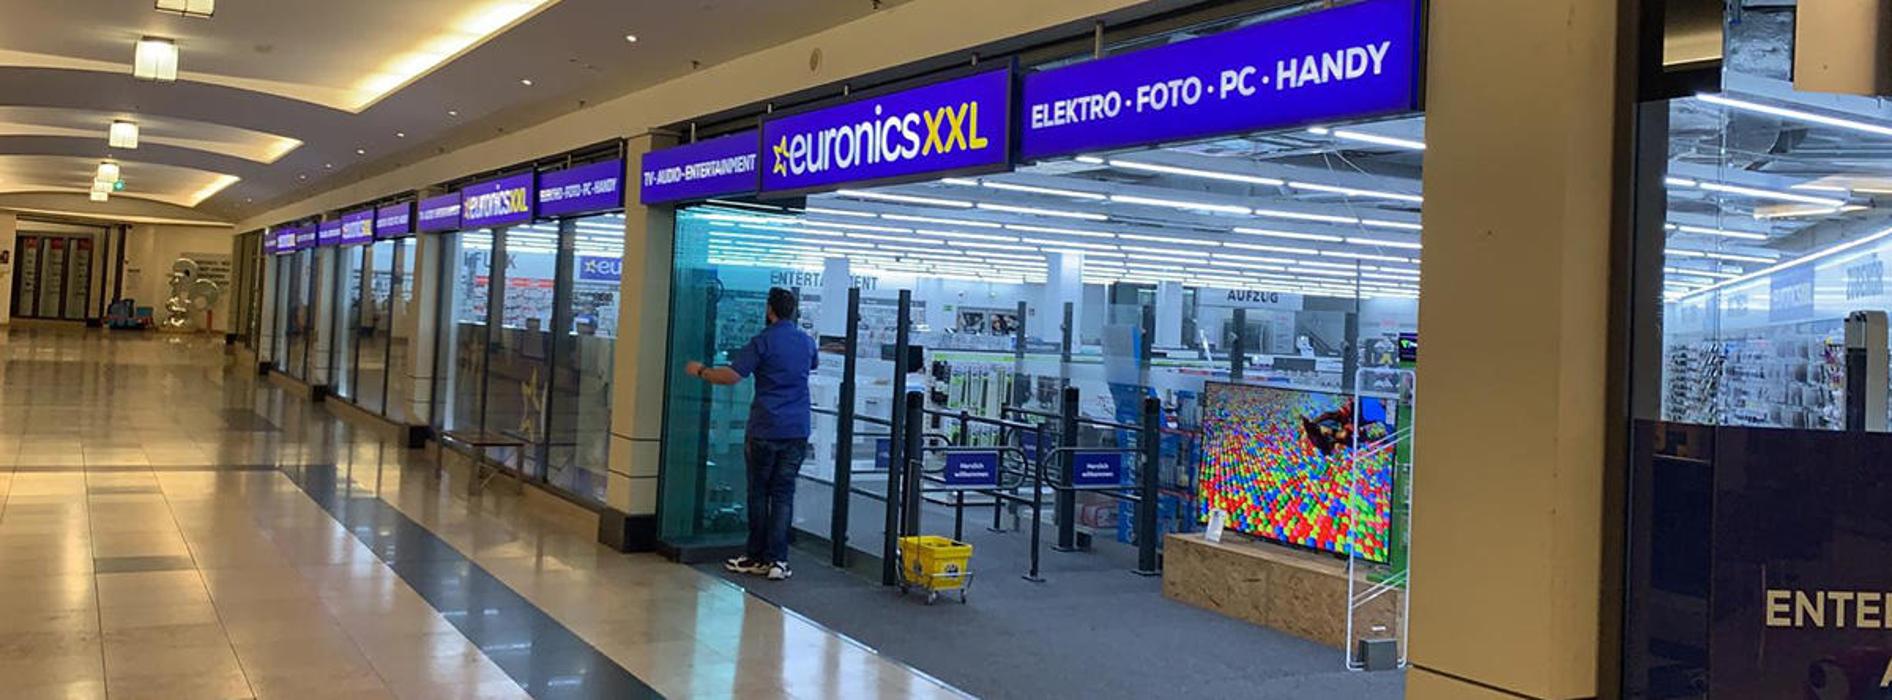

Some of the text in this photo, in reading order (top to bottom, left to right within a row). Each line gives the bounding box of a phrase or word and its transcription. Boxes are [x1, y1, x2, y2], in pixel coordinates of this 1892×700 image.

[1031, 41, 1391, 129] ELEKTRO FOTO PC HANDY
[643, 154, 757, 187] TV AUDIO ENTERTAINMENT
[770, 270, 878, 290] ENTERTENT
[1227, 289, 1279, 304] AUFZUG
